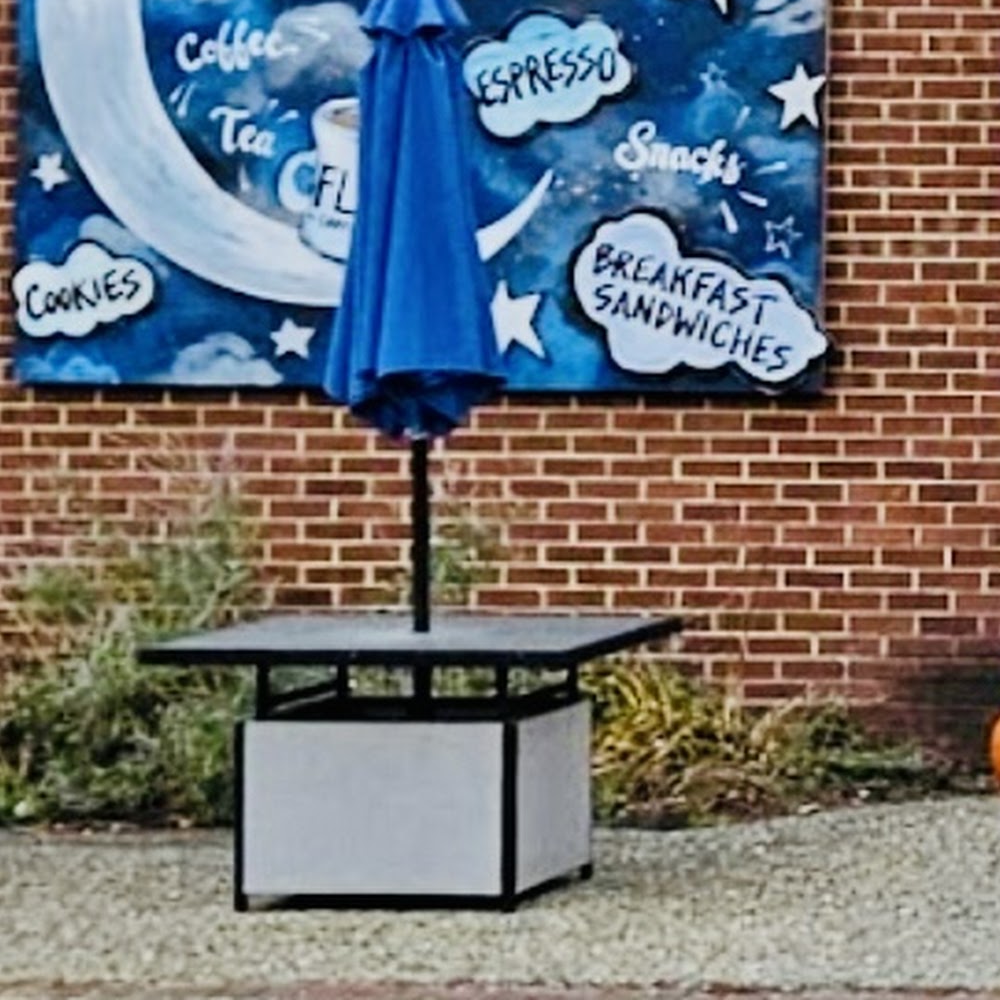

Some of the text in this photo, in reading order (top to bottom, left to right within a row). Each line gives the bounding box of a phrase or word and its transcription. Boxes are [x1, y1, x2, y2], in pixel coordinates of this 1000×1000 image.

[175, 18, 298, 73] Coffee
[476, 43, 618, 106] ESPRESSO
[209, 105, 277, 155] Tea
[613, 119, 746, 186] Snacks
[25, 267, 142, 320] COOKIES
[593, 242, 777, 326] BREAKFAST
[593, 283, 794, 372] SANDWICHES
